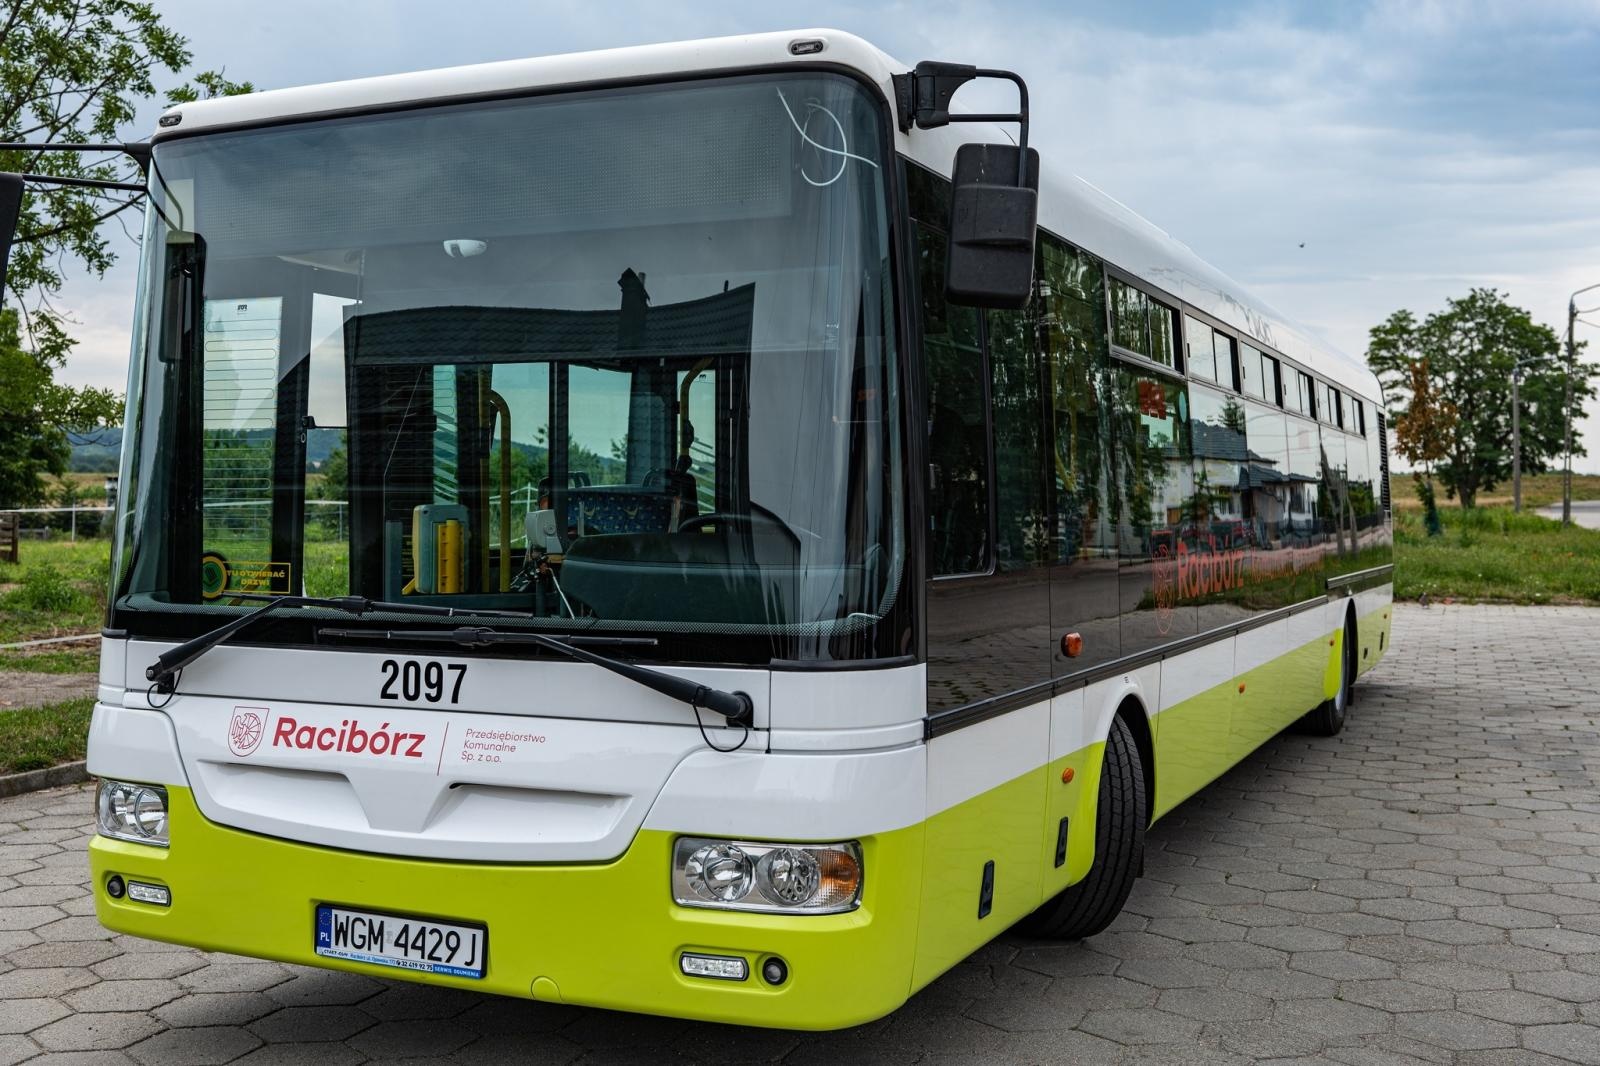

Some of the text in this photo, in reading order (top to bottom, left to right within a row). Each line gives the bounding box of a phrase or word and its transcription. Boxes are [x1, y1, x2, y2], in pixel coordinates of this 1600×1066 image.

[241, 578, 270, 586] DRZWI
[380, 659, 467, 704] 2097
[272, 716, 426, 758] Racibórz
[465, 728, 546, 744] Przedsiębiorstwo
[463, 739, 516, 753] Komunalne
[461, 750, 502, 763] Sp. z o.o.
[320, 931, 330, 942] PL
[334, 913, 385, 953] WGM
[408, 961, 418, 969] 419
